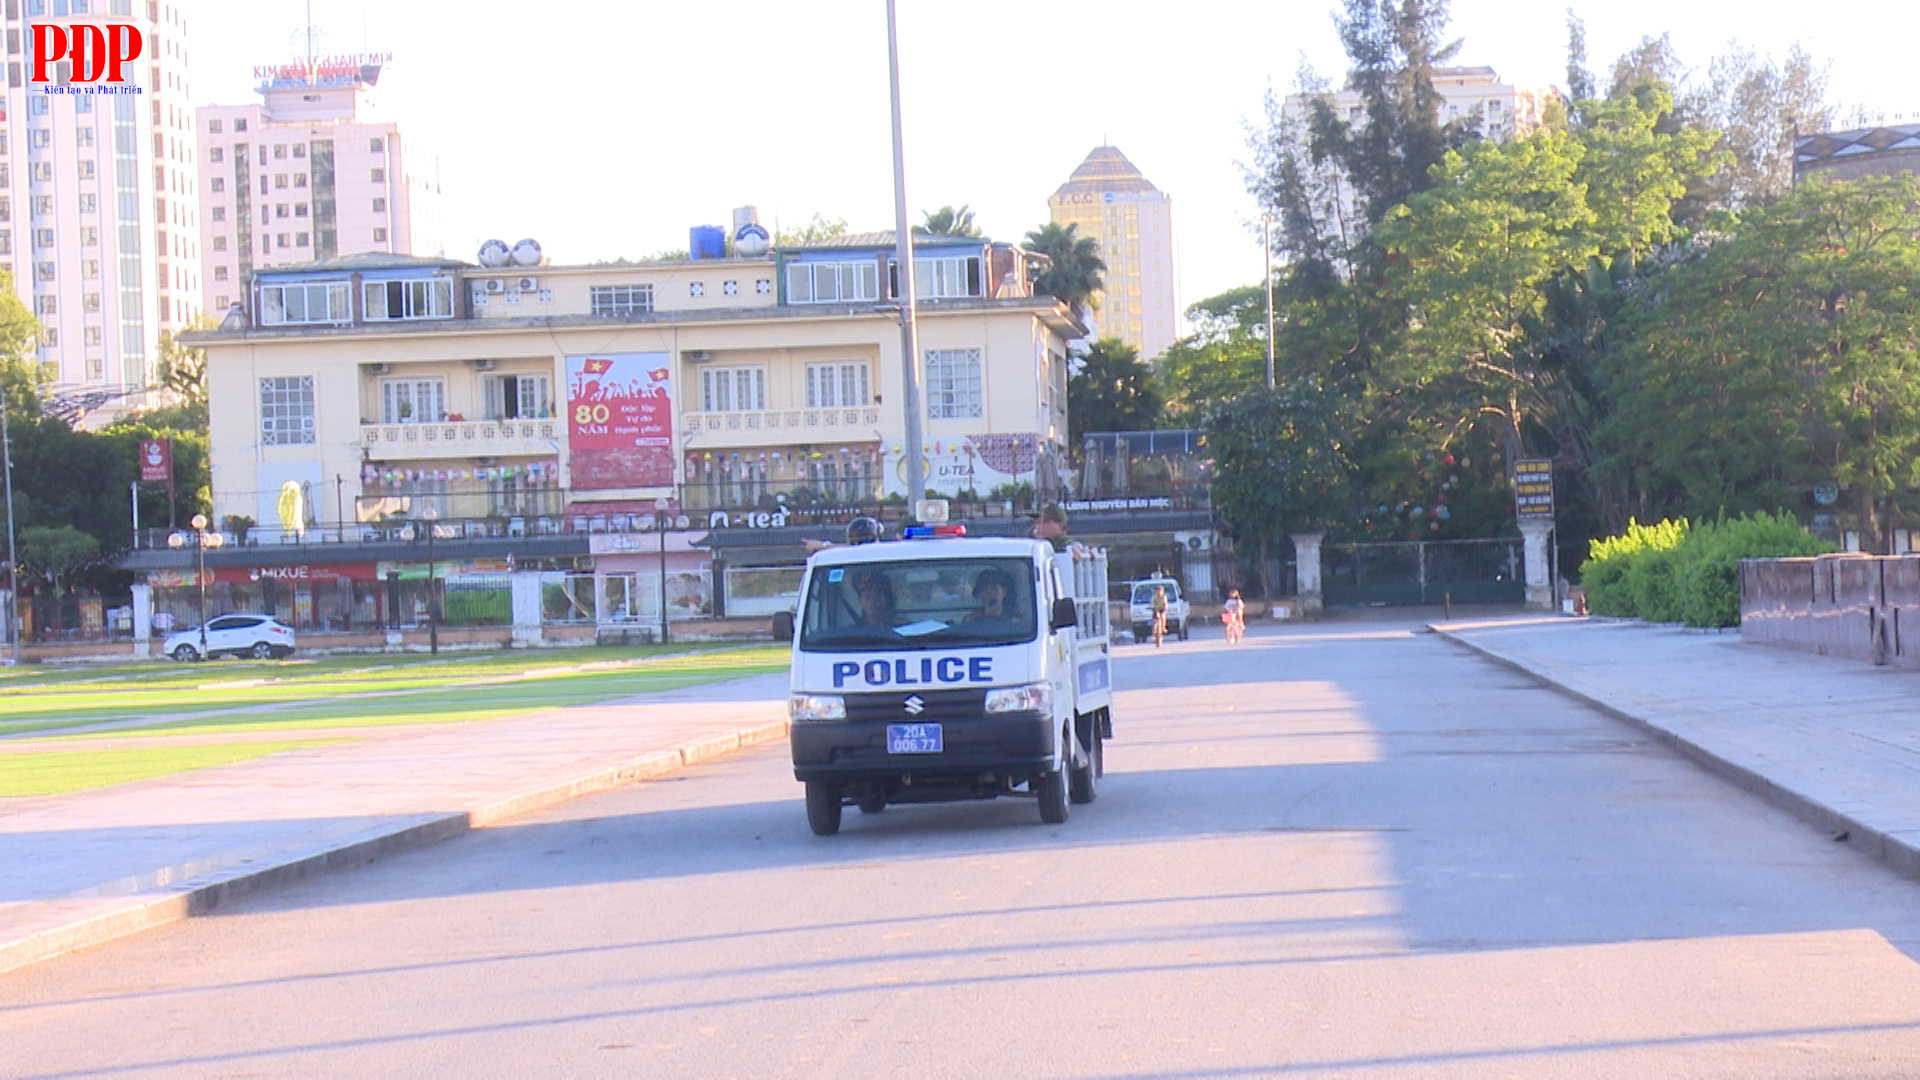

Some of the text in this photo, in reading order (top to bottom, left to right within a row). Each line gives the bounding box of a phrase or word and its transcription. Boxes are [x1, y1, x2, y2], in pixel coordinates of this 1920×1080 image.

[575, 403, 610, 434] 80 NĂM
[261, 565, 309, 579] MIXUE
[832, 656, 994, 688] POLICE
[903, 725, 927, 738] 20A
